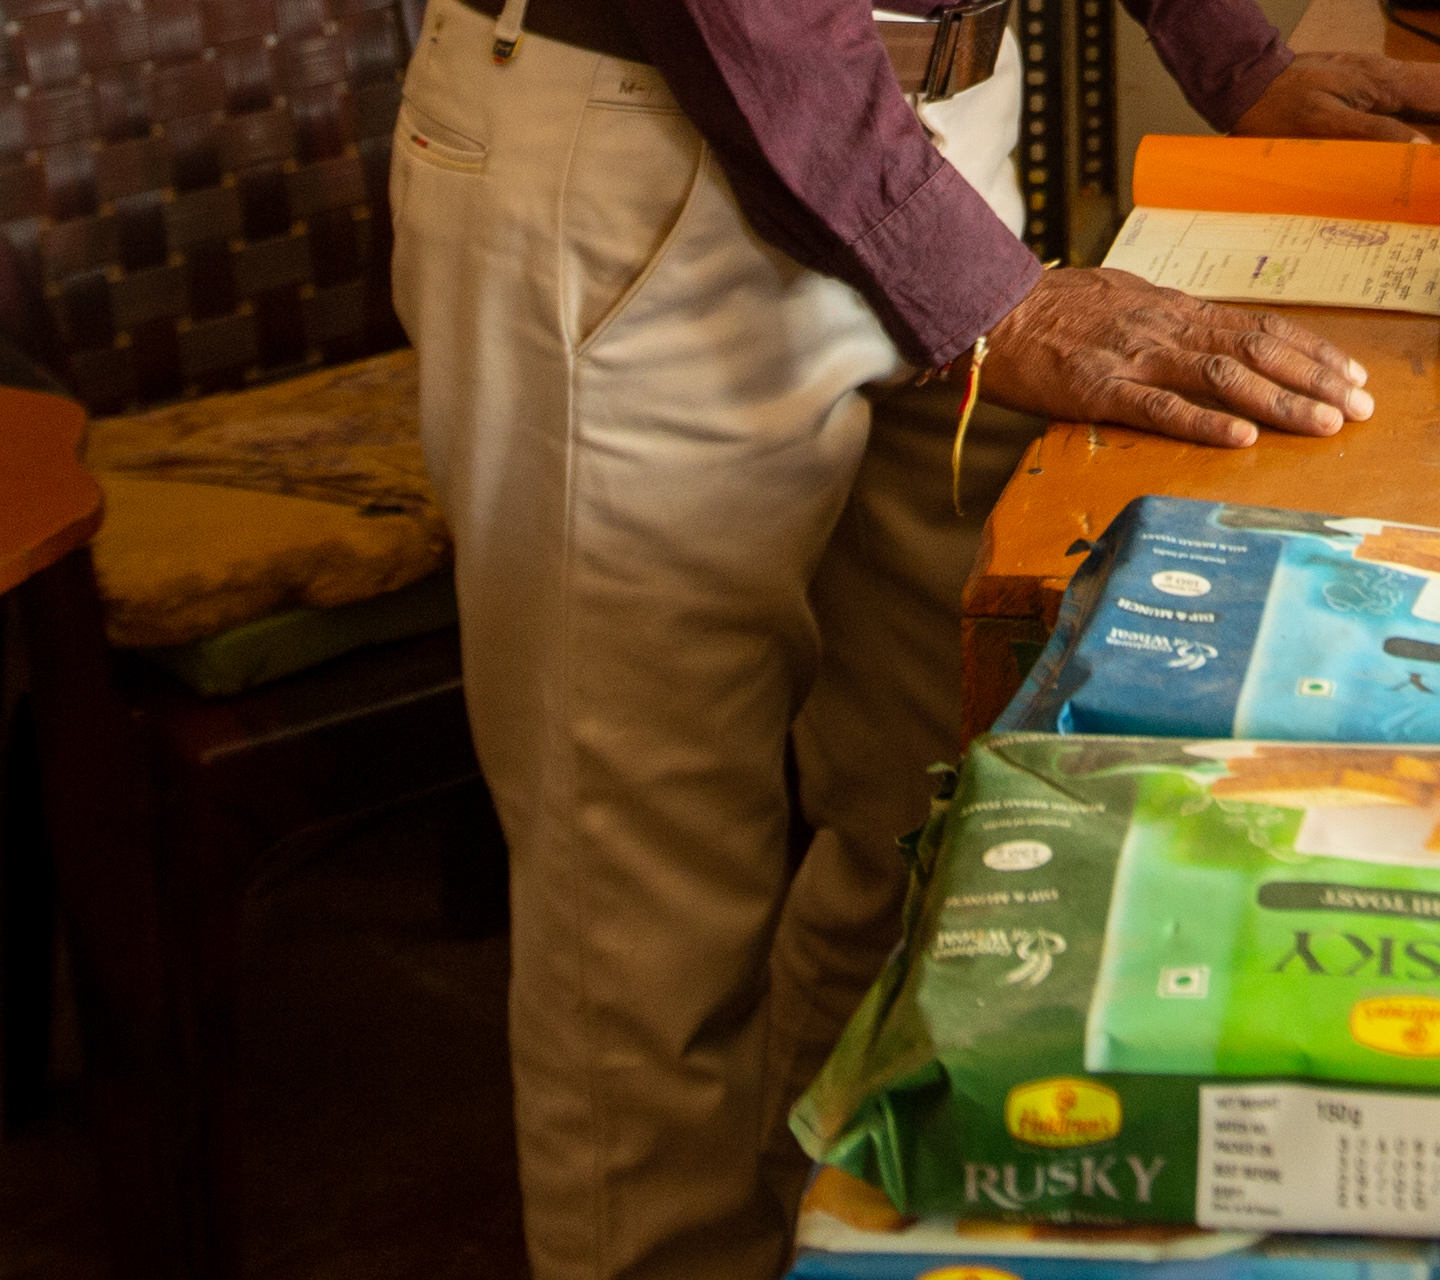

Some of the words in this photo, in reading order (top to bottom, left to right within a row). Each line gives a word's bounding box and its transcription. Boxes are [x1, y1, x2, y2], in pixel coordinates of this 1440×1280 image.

[1116, 597, 1174, 620] MUNCH
[1187, 612, 1215, 623] DIP
[1319, 890, 1410, 914] TOAST
[962, 1155, 1166, 1211] RUSKY
